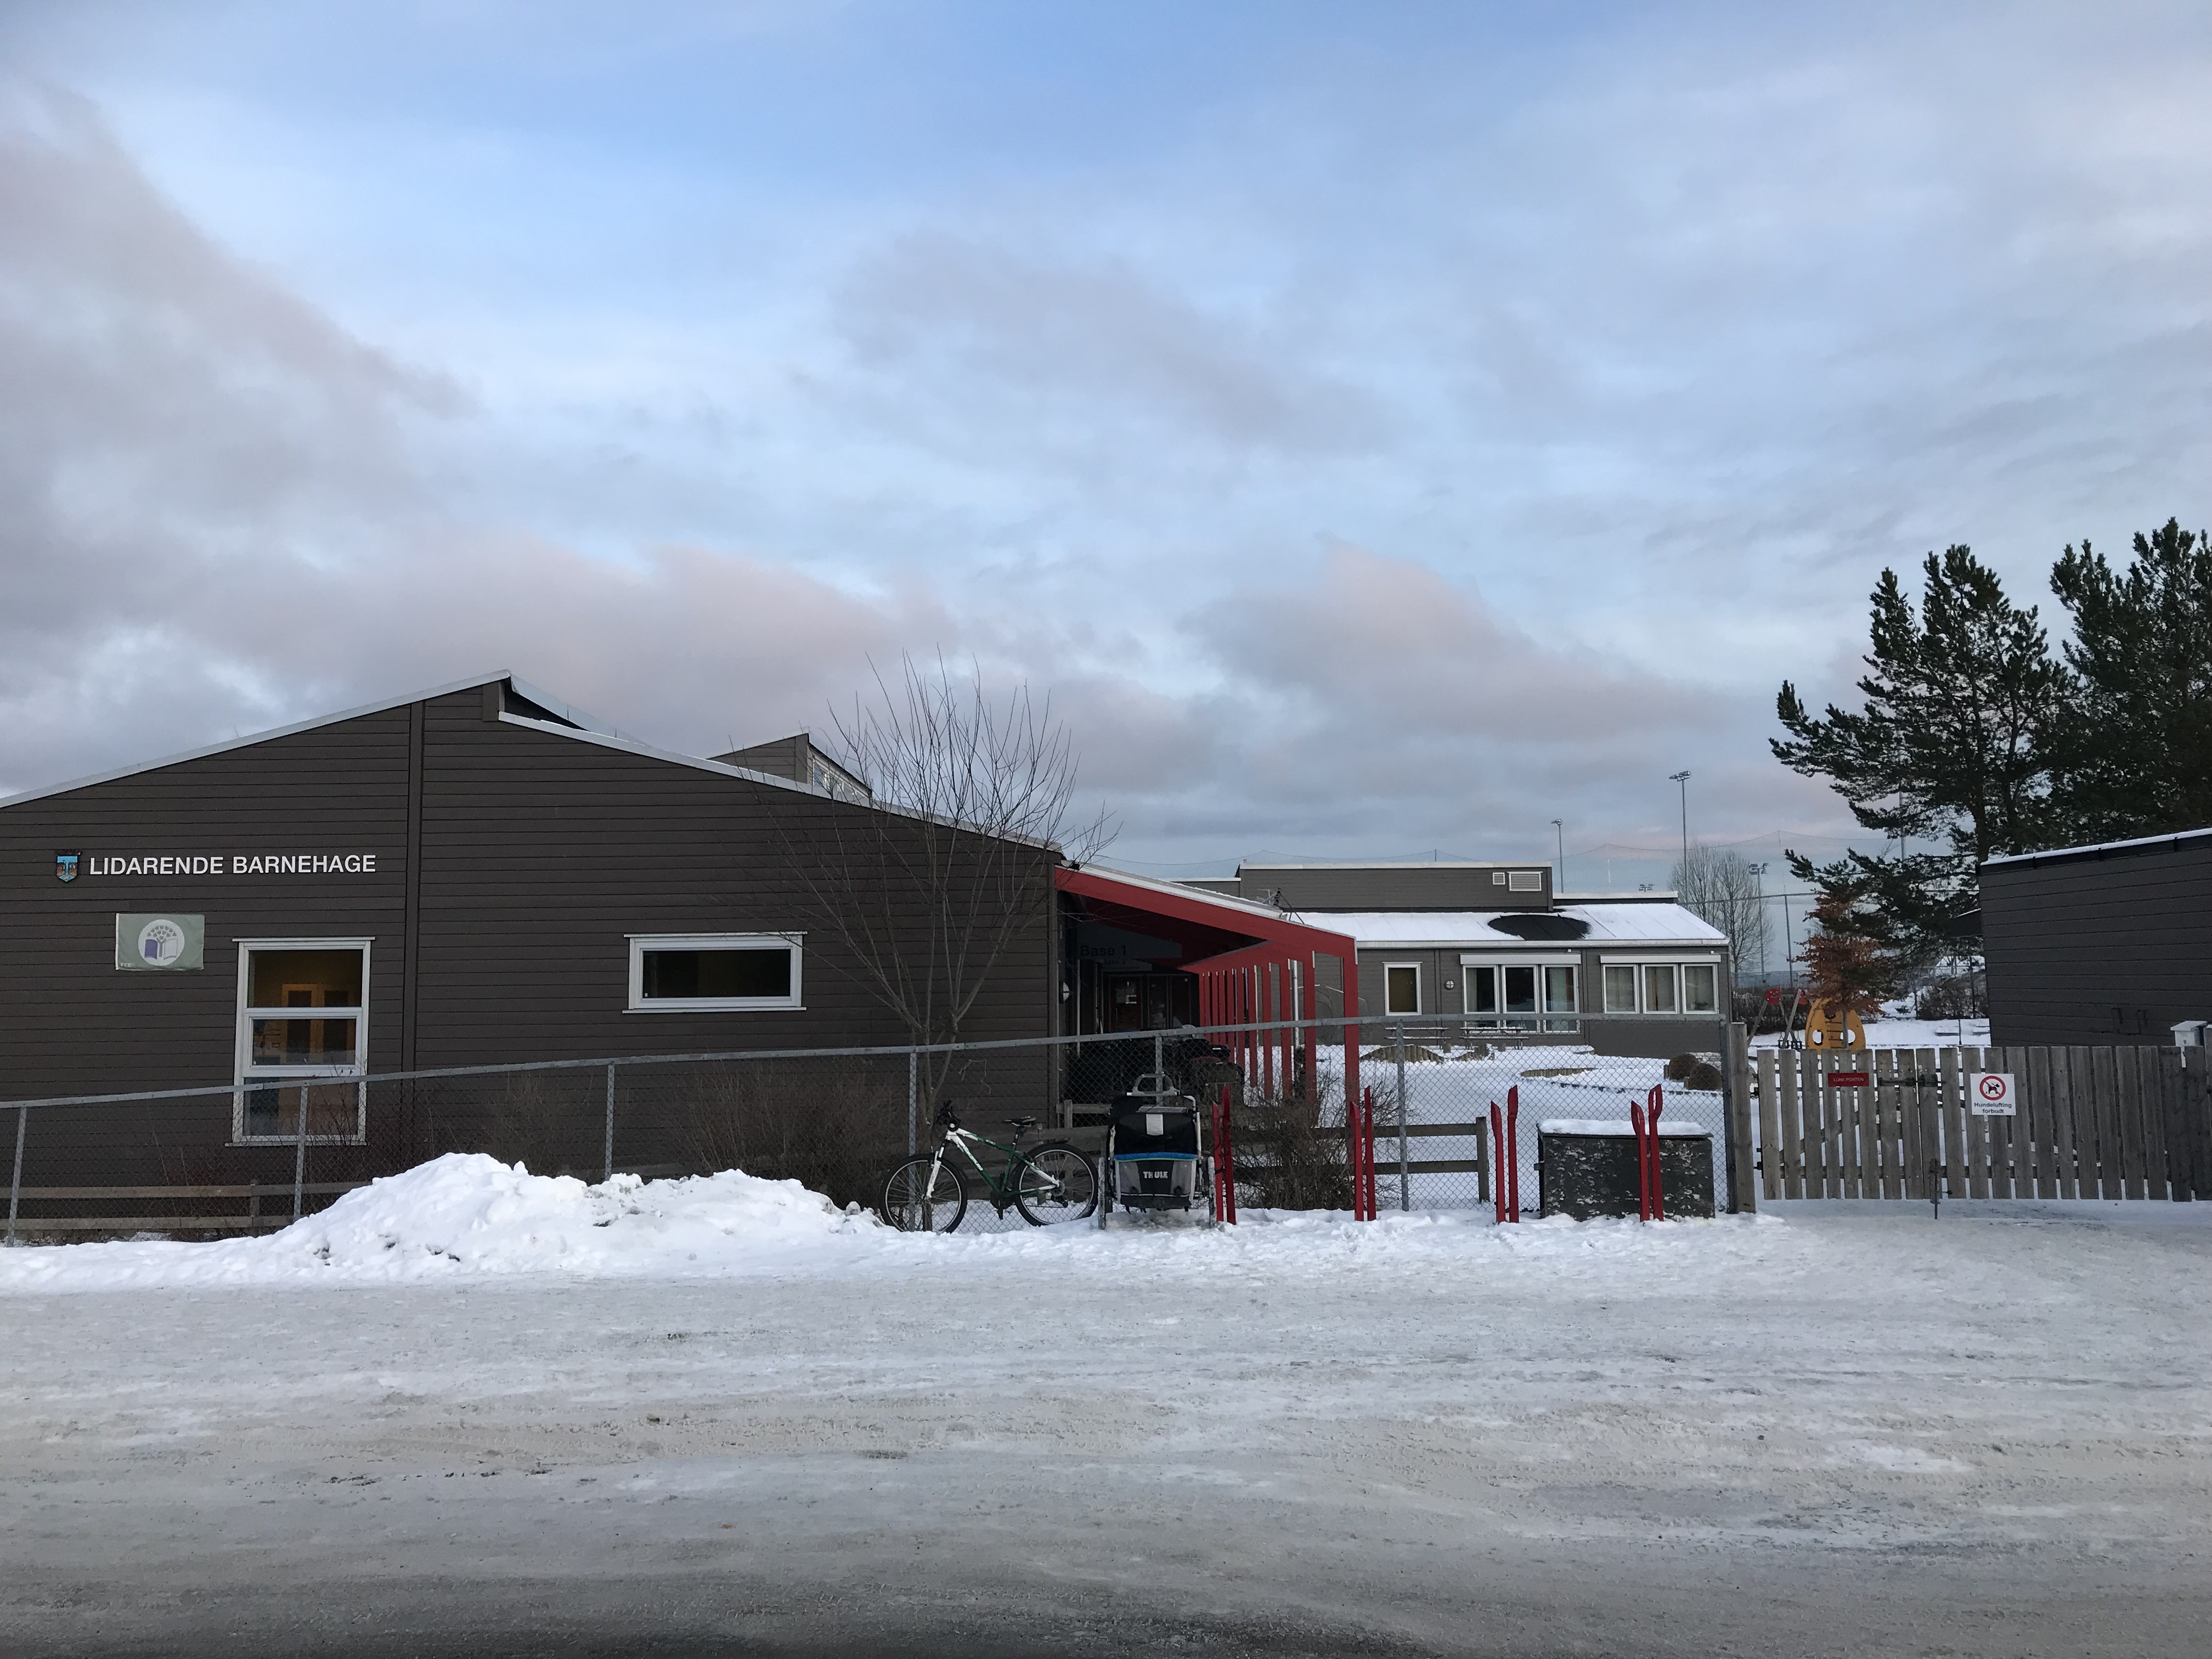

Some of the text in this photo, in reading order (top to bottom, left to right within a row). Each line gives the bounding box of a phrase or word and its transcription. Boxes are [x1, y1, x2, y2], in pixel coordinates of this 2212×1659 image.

[89, 855, 376, 875] LIDARENDE BARNEHAGE
[1080, 945, 1126, 957] Base 1
[1143, 1171, 1168, 1179] THULE
